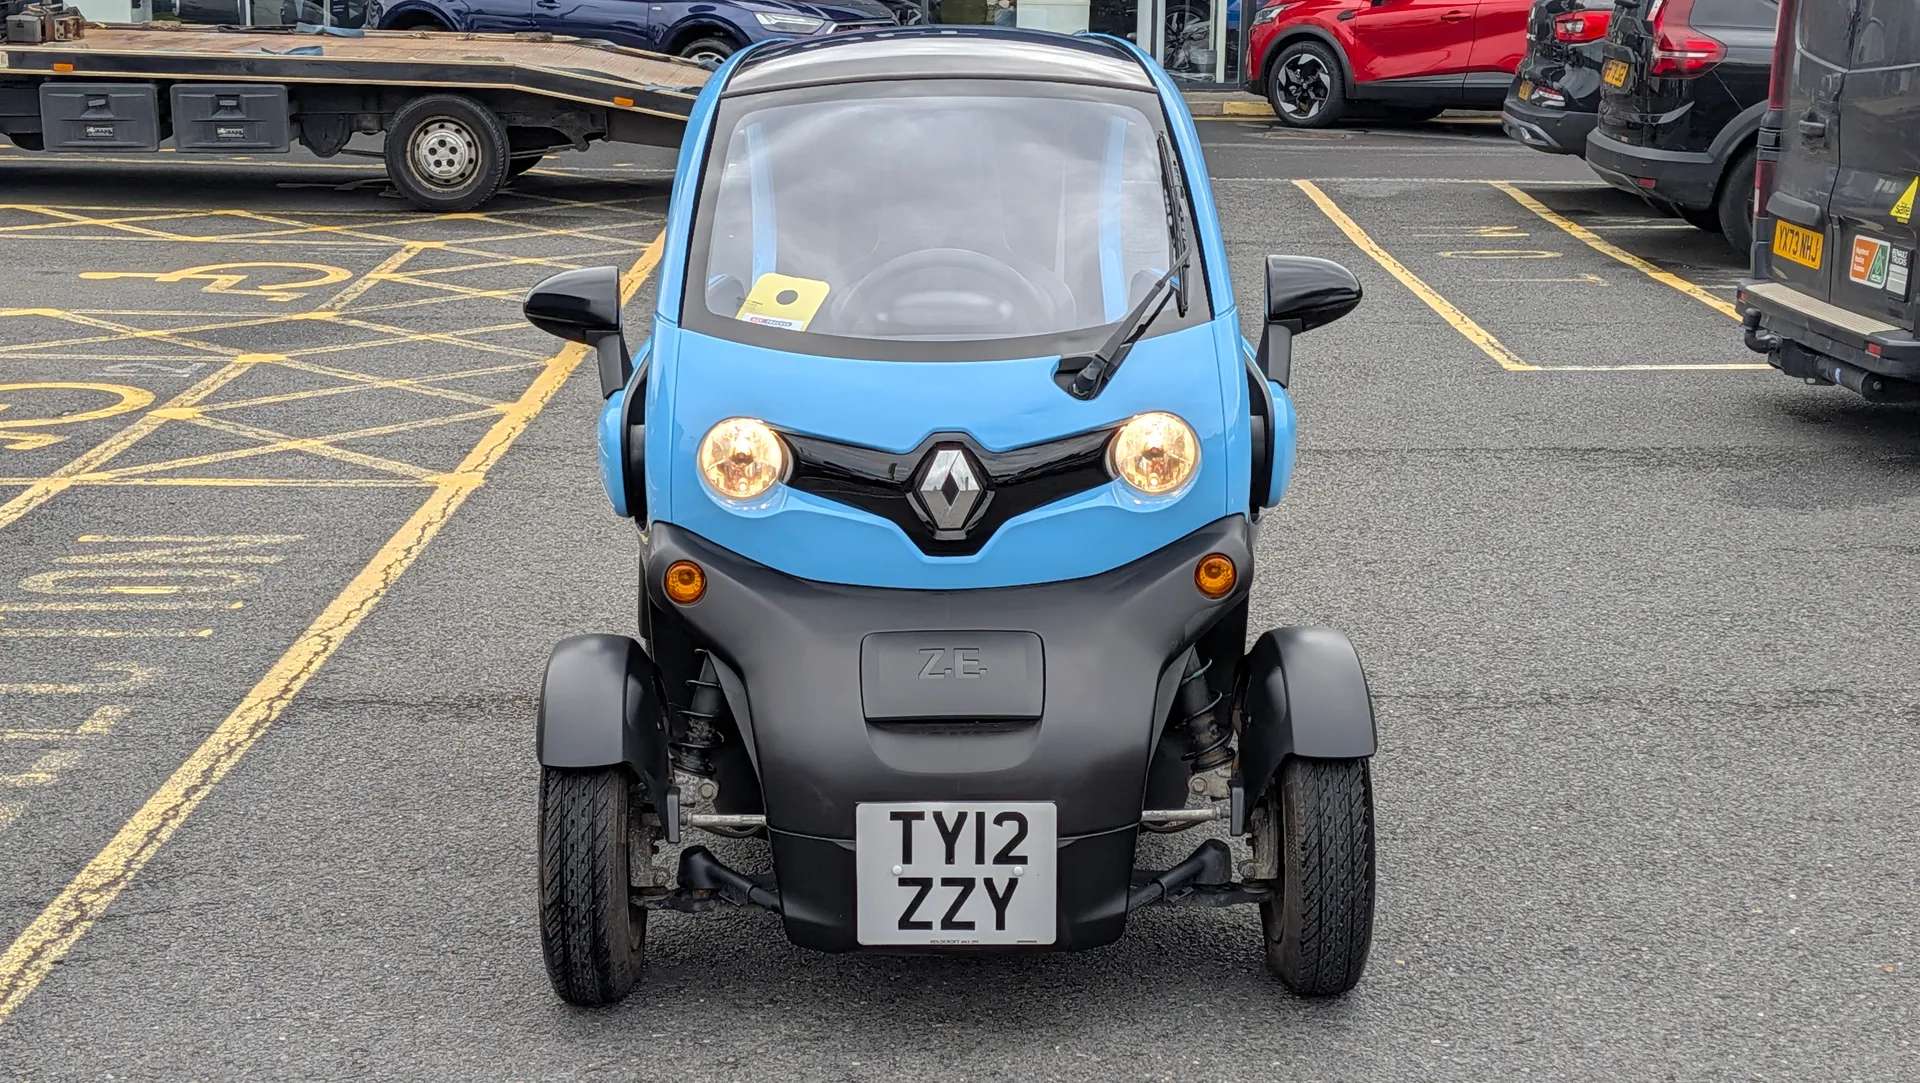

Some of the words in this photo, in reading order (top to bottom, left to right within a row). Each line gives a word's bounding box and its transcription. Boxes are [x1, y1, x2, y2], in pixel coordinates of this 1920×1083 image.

[1779, 225, 1801, 252] YX73
[1800, 233, 1820, 263] NHJ
[889, 811, 1029, 865] TY12
[897, 877, 1019, 931] ZZY
